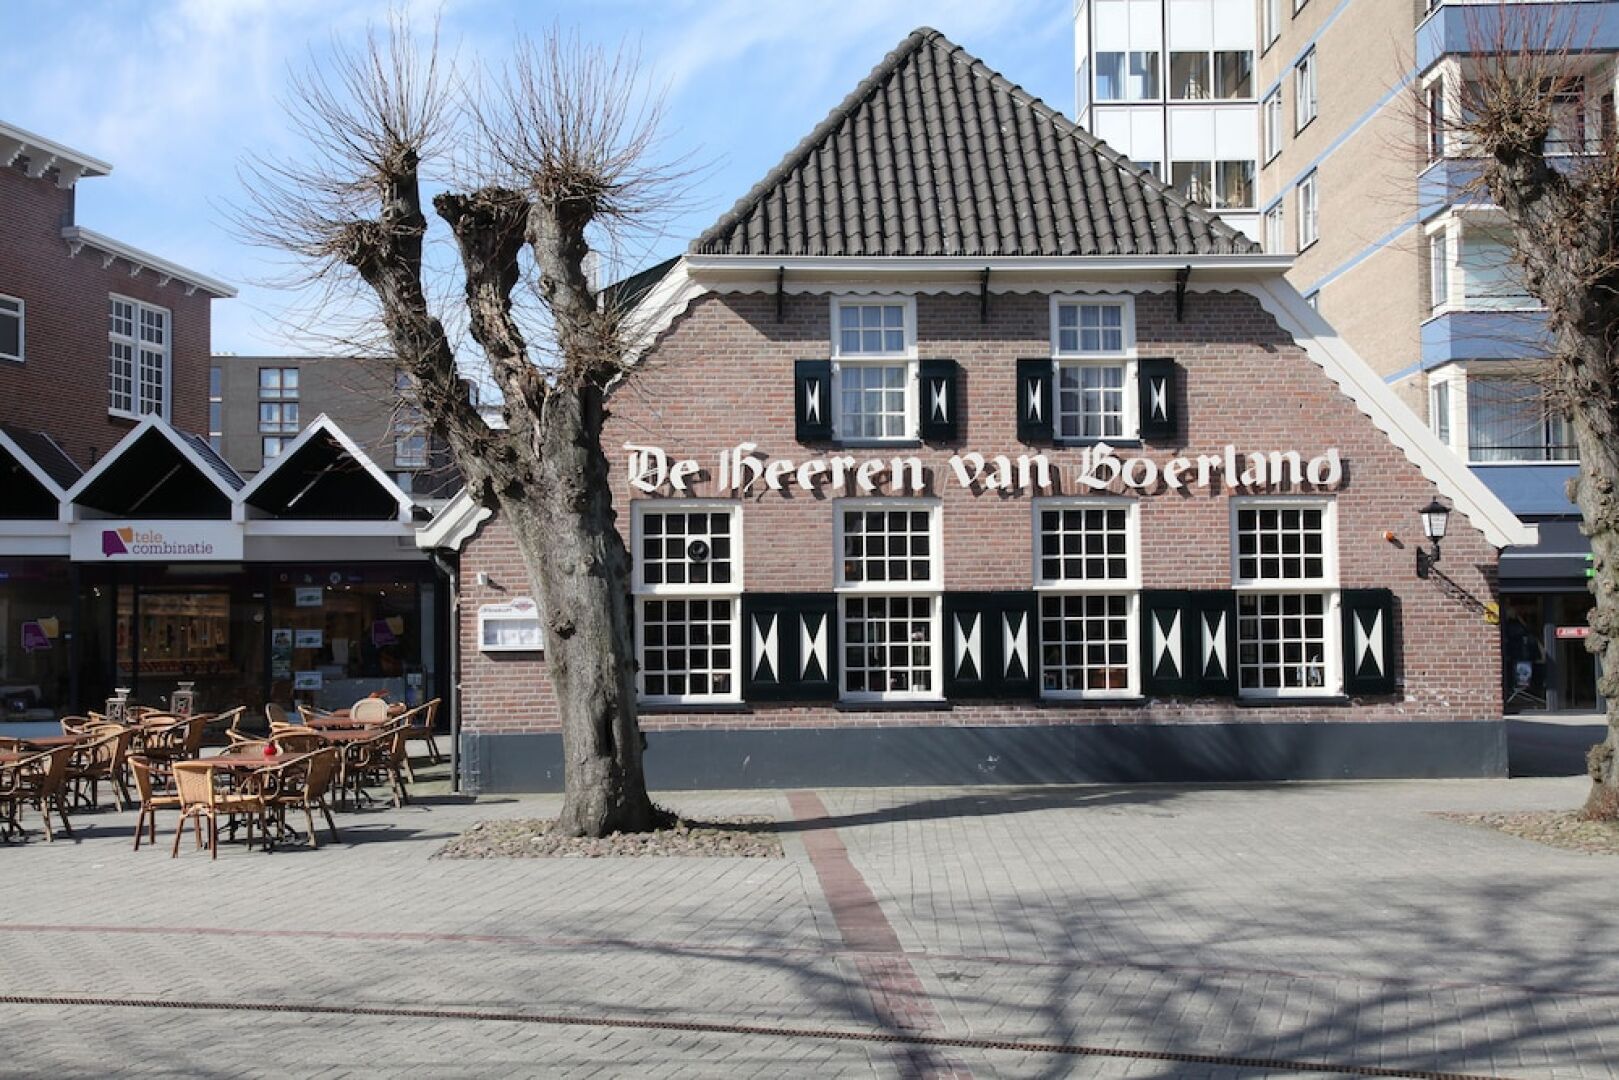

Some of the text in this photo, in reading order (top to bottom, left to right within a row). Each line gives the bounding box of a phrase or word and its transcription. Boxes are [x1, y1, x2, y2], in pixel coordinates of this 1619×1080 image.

[622, 441, 700, 492] De
[948, 451, 1052, 490] van
[135, 530, 163, 543] tele
[132, 540, 214, 554] combinatie
